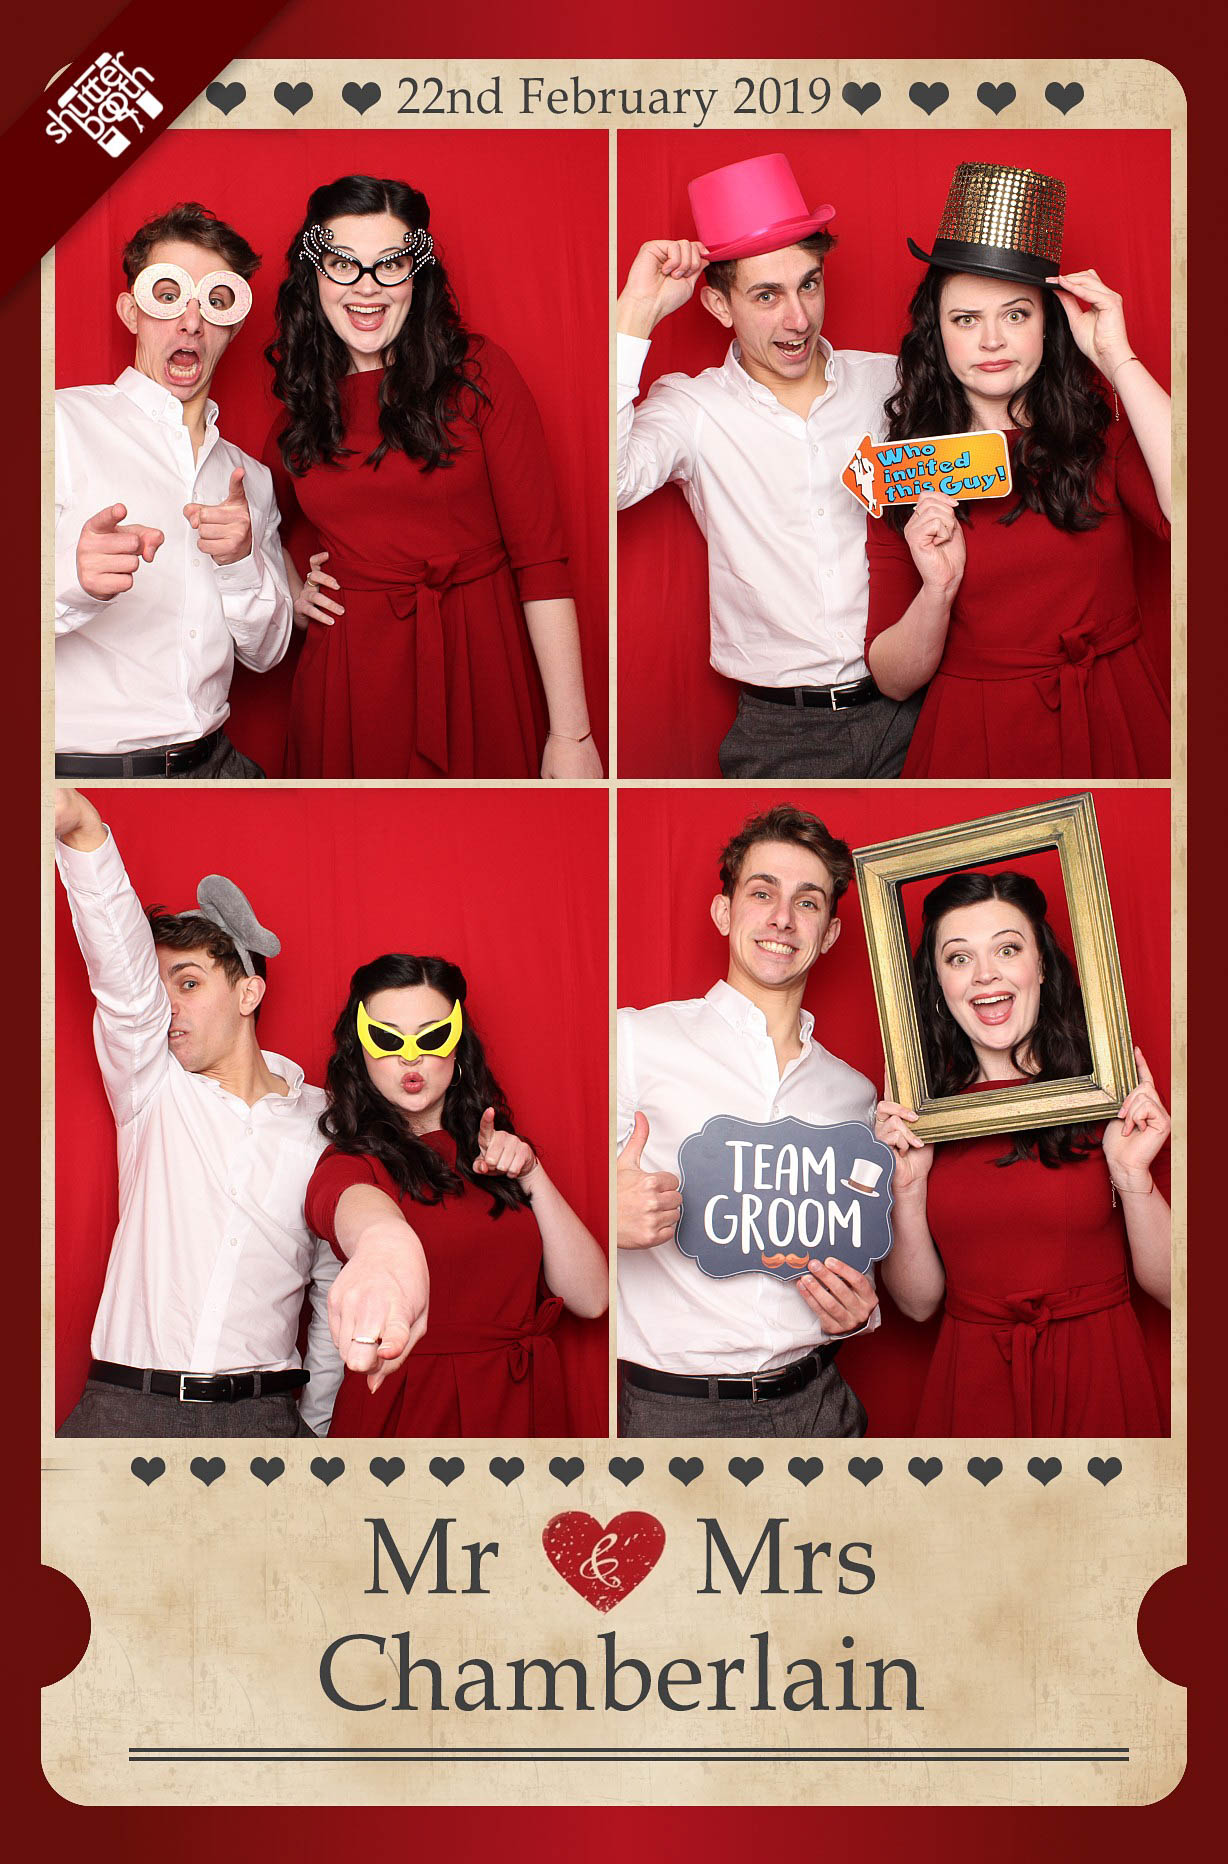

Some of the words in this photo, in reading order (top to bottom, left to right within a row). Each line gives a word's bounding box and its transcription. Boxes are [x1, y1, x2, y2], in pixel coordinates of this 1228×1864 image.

[876, 443, 936, 467] Who
[883, 450, 971, 483] invited
[885, 480, 935, 502] this
[938, 465, 1007, 497] Guy!
[724, 1140, 836, 1196] TEAM
[703, 1193, 862, 1255] GROOM
